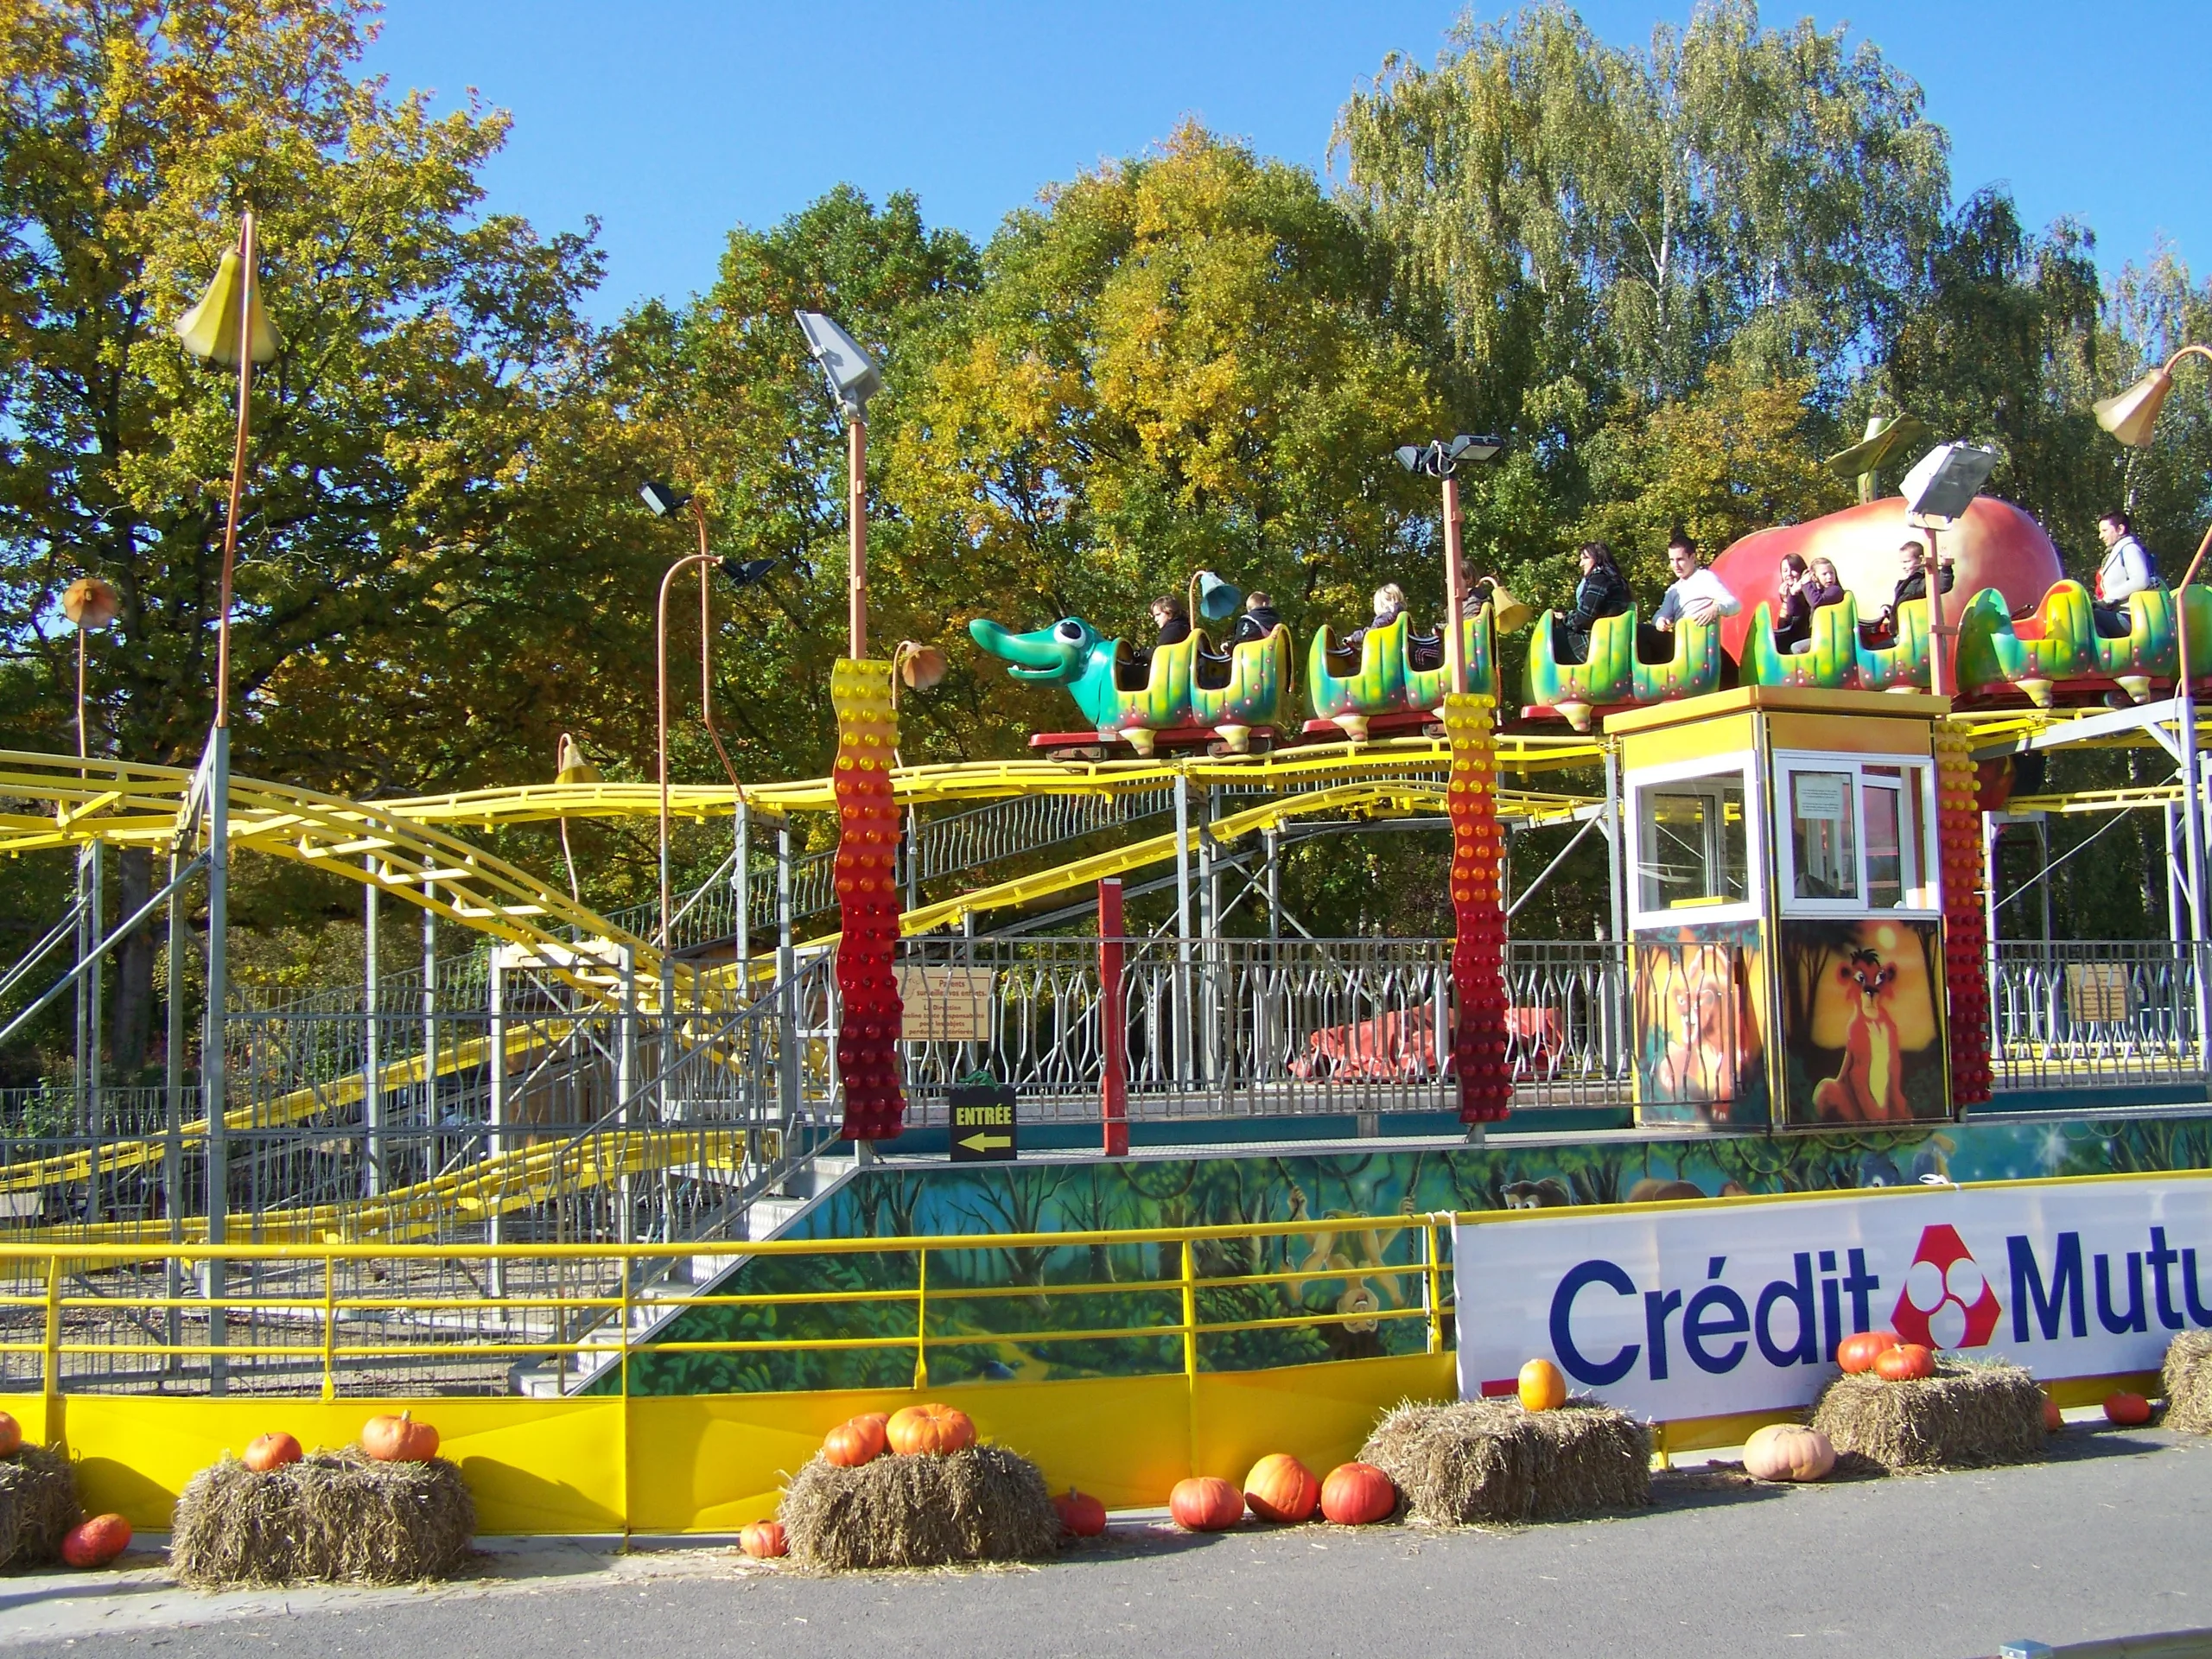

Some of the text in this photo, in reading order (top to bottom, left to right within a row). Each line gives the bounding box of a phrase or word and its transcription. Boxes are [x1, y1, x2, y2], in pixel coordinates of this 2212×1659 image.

[938, 979, 965, 988] Paents
[956, 1103, 1012, 1126] ENTRÉE
[1549, 1248, 1880, 1386] Crédit
